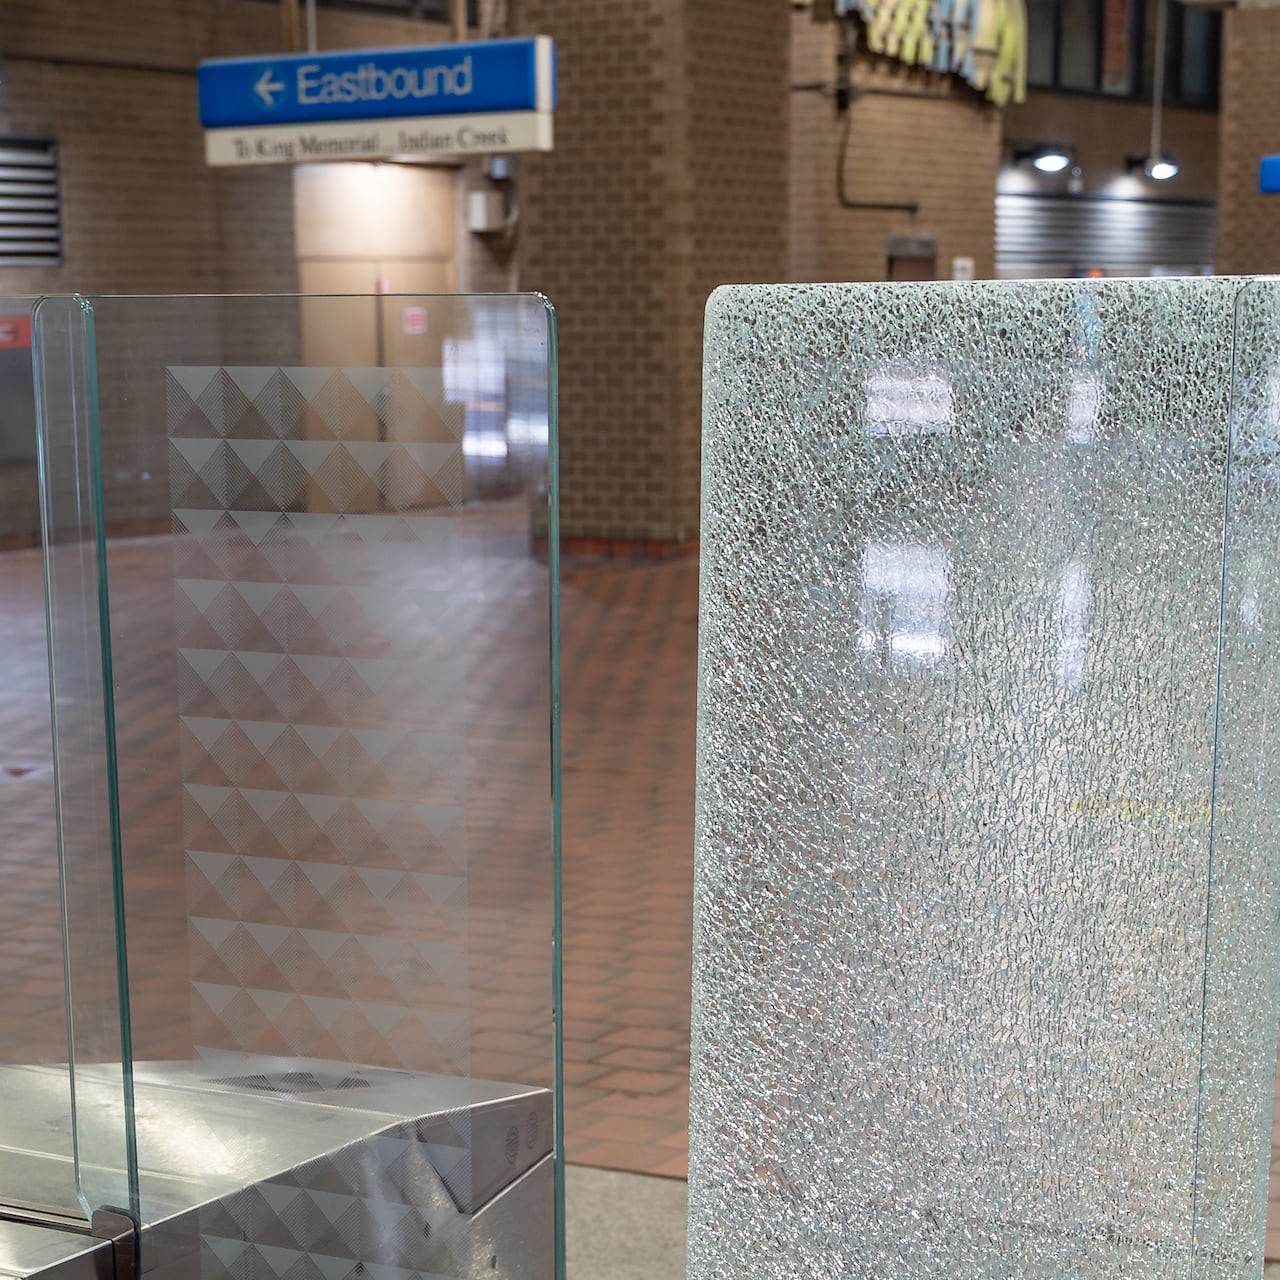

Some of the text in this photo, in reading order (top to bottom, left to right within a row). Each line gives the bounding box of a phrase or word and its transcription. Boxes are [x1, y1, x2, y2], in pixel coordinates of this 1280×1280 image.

[296, 56, 473, 105] Eastbound
[233, 124, 510, 158] To King Memorial Indian Creek
